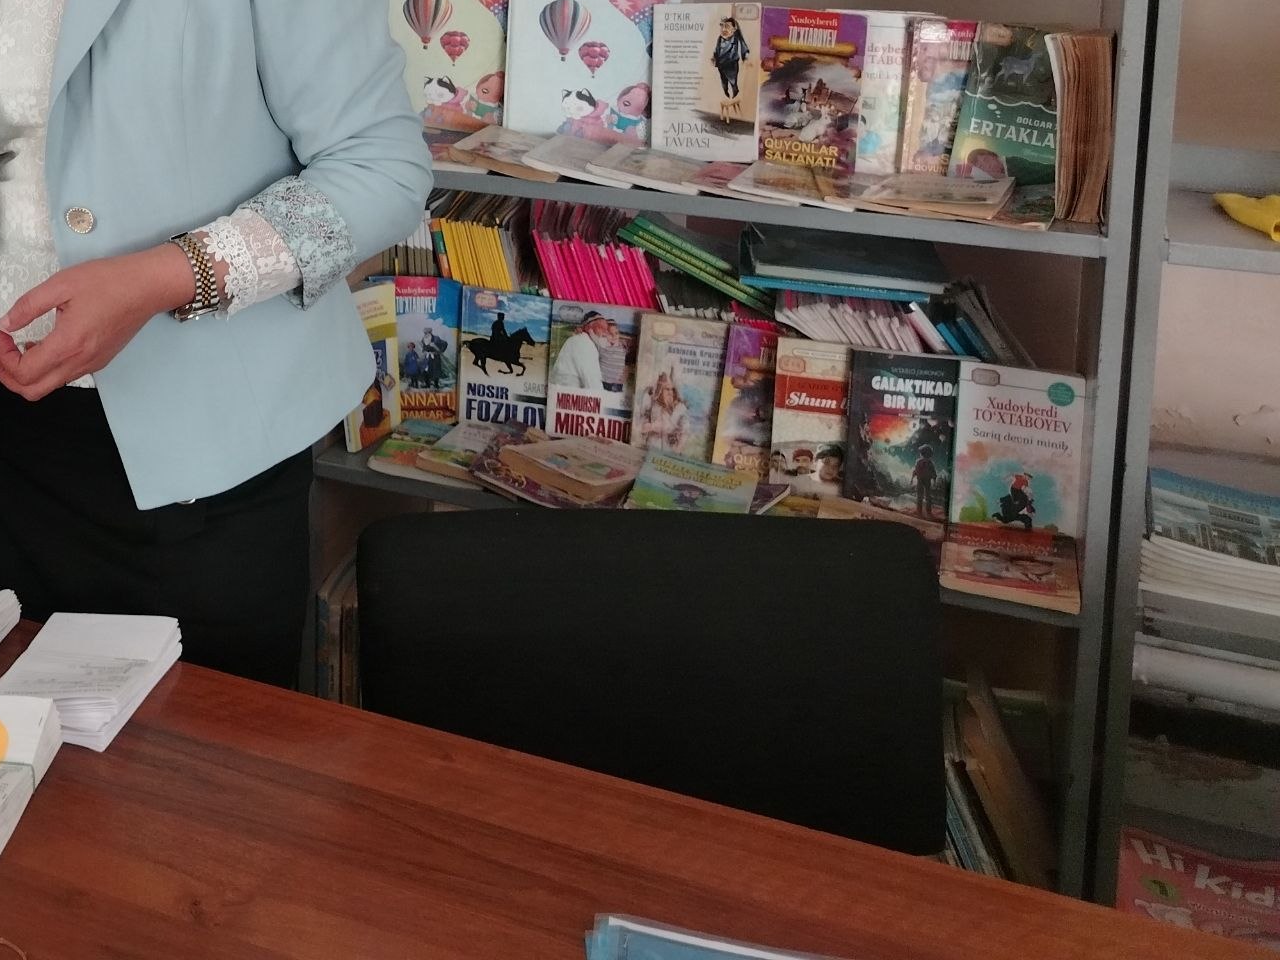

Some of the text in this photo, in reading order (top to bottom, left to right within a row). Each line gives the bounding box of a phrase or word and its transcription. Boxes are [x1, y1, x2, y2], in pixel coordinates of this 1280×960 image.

[664, 22, 705, 32] HOSHIMOV
[789, 14, 838, 27] Xudoyberdi
[664, 136, 710, 149] TAVBASI
[764, 138, 839, 157] QUYONLAR
[764, 149, 837, 169] SALTANATI
[466, 382, 509, 400] NOSIR
[785, 391, 837, 409] Shum
[556, 392, 601, 415] MIRMUHSIN
[883, 393, 935, 412] BIR KUN
[987, 396, 1058, 419] Xudoyberdi
[972, 407, 1072, 434] TO'XTABOYEV
[972, 427, 1001, 442] Sariq
[1130, 839, 1185, 872] Hi
